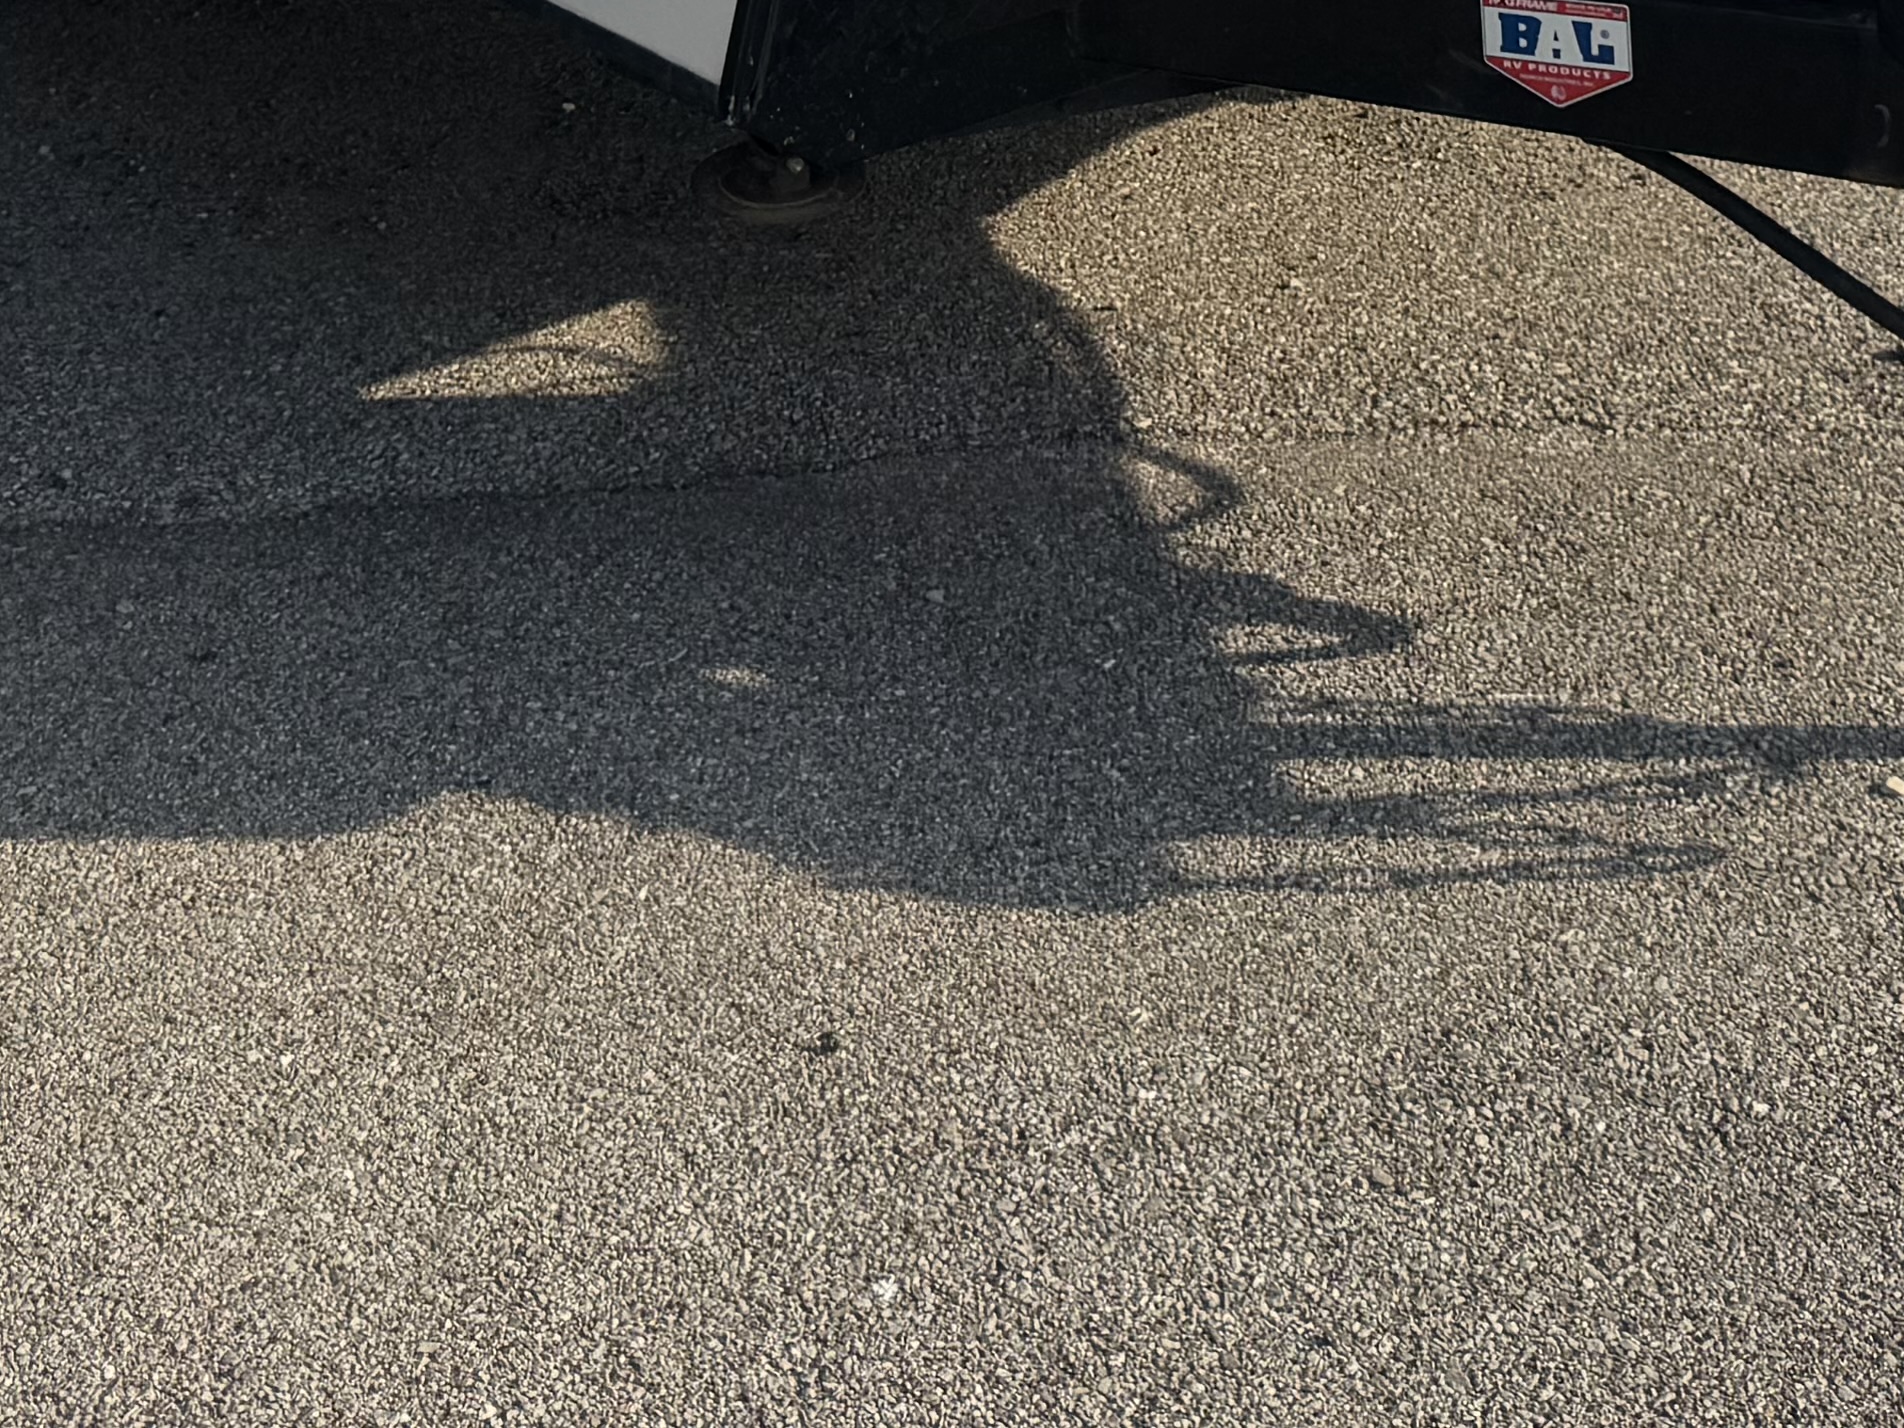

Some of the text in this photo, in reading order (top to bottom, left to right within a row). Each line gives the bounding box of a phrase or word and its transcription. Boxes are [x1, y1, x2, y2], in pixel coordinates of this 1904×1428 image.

[1498, 12, 1615, 65] BAL
[1503, 60, 1522, 70] RV
[1528, 63, 1611, 80] PRODUCTS
